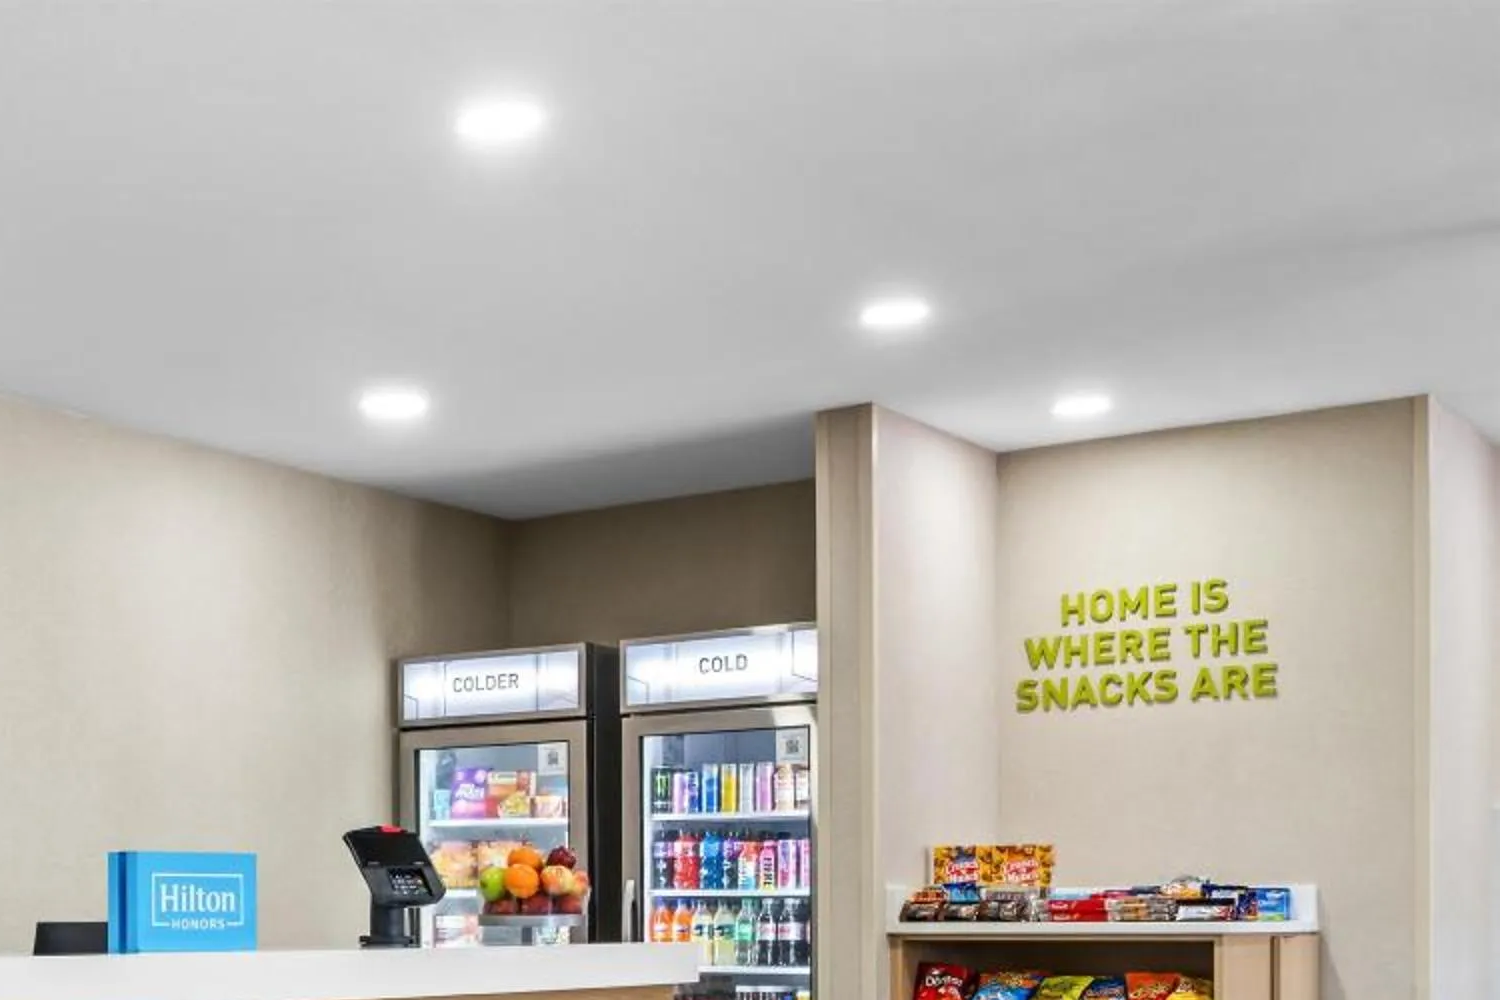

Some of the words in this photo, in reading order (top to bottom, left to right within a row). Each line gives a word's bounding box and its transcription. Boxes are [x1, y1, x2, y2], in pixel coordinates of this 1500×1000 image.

[1060, 583, 1178, 627] HOME
[1190, 578, 1230, 616] IS
[1024, 627, 1172, 671] WHERE
[1184, 619, 1269, 659] THE
[699, 653, 749, 674] COLD
[452, 673, 520, 693] COLDER
[1016, 669, 1180, 714] SNACKS
[1191, 663, 1279, 703] ARE
[160, 883, 237, 913] Hilton
[171, 918, 227, 931] HONORS
